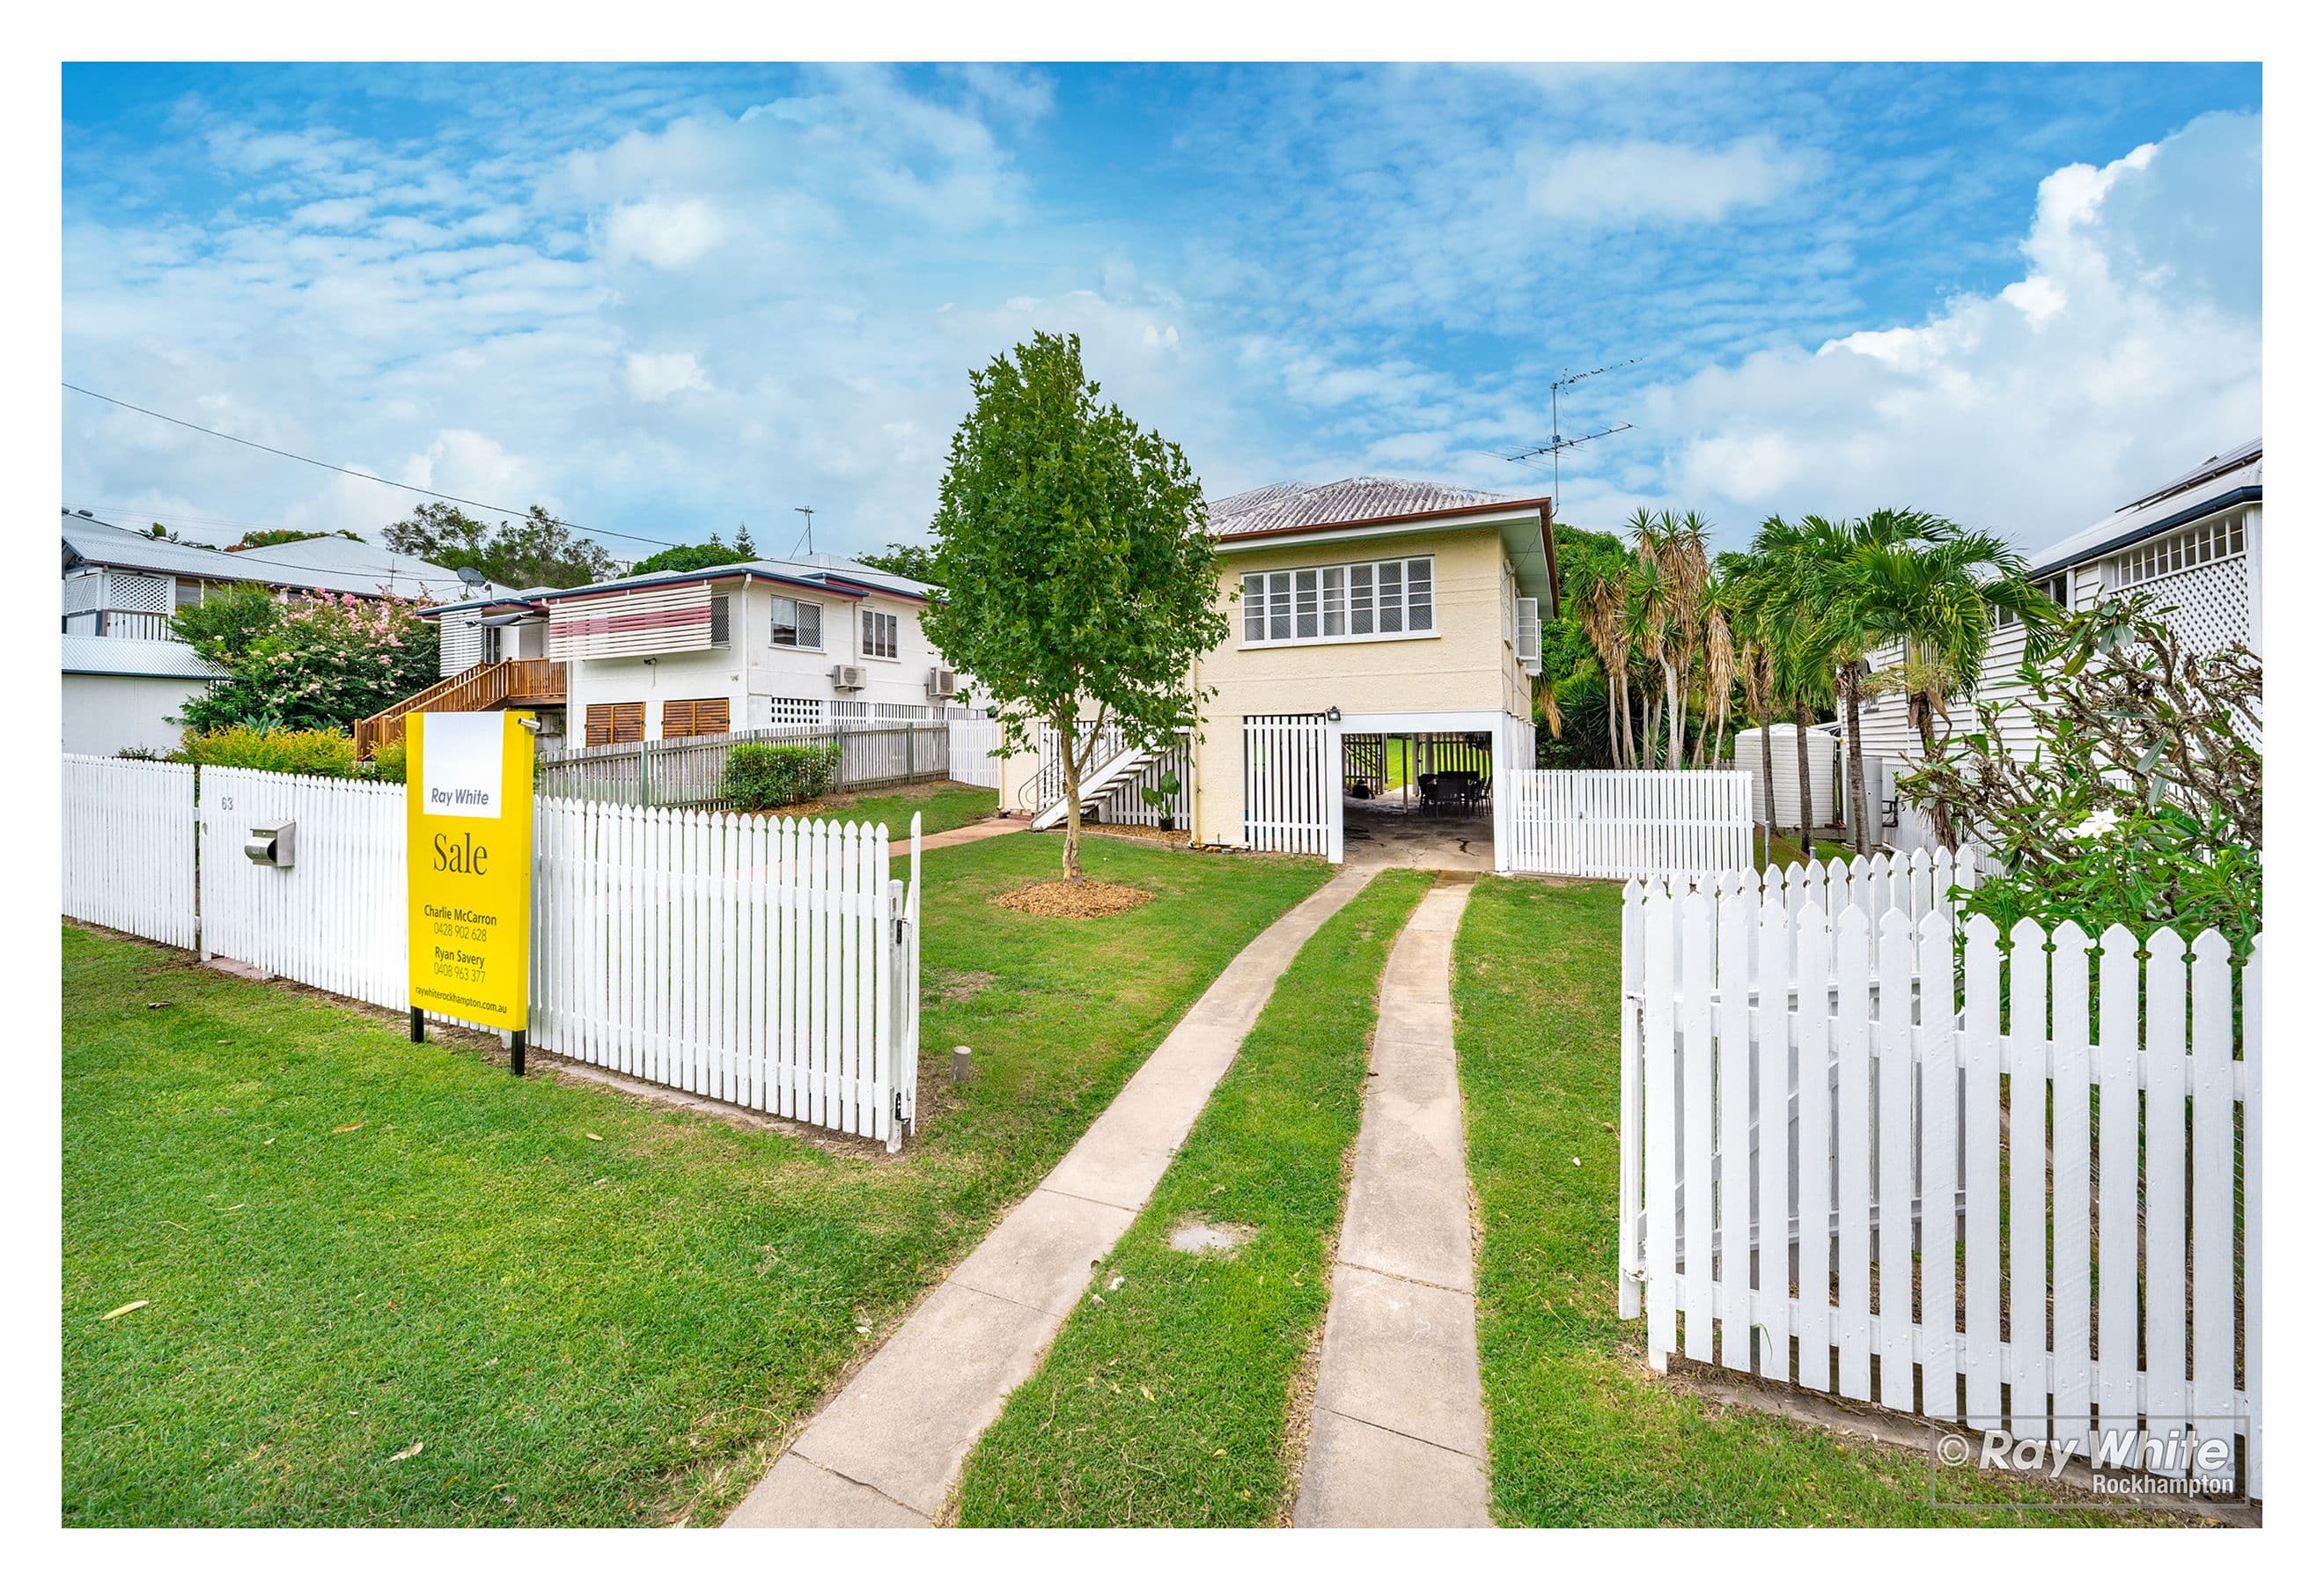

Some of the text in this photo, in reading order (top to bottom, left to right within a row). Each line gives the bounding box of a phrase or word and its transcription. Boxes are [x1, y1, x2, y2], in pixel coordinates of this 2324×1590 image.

[222, 797, 233, 811] 63
[430, 787, 489, 806] Ray White
[433, 832, 488, 876] Sale
[424, 904, 497, 925] Charlie McCarron
[434, 922, 487, 942] 0428 902 628
[435, 946, 485, 968] Ryan Savery
[434, 962, 486, 983] 0408 963 377
[415, 986, 507, 1014] raywhiterockhampton.com.au
